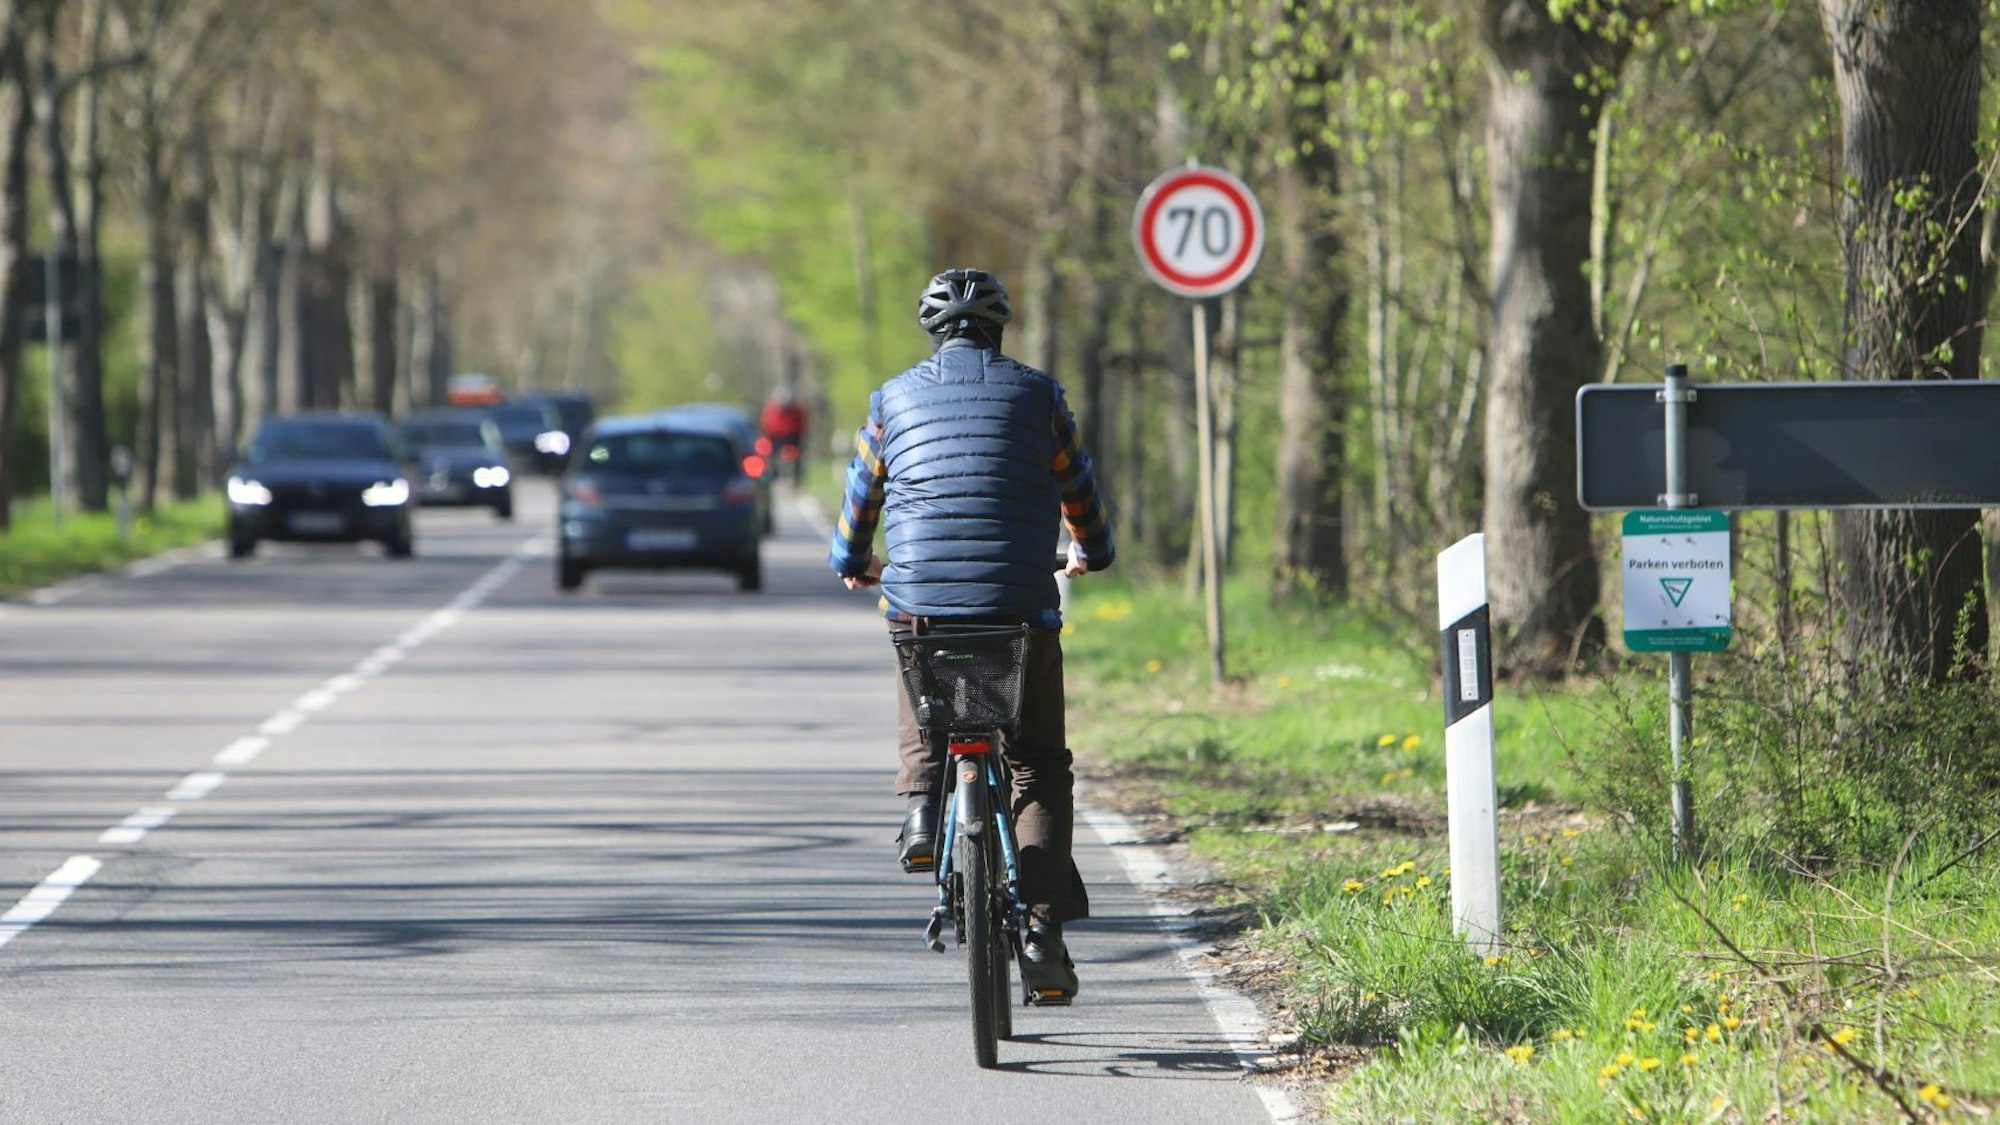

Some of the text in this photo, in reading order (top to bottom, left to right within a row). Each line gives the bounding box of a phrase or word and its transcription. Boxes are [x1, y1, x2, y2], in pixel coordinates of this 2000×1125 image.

[1168, 205, 1231, 258] 70
[1639, 514, 1712, 524] Naturschutzgebiet
[1629, 559, 1724, 569] Parken verboten
